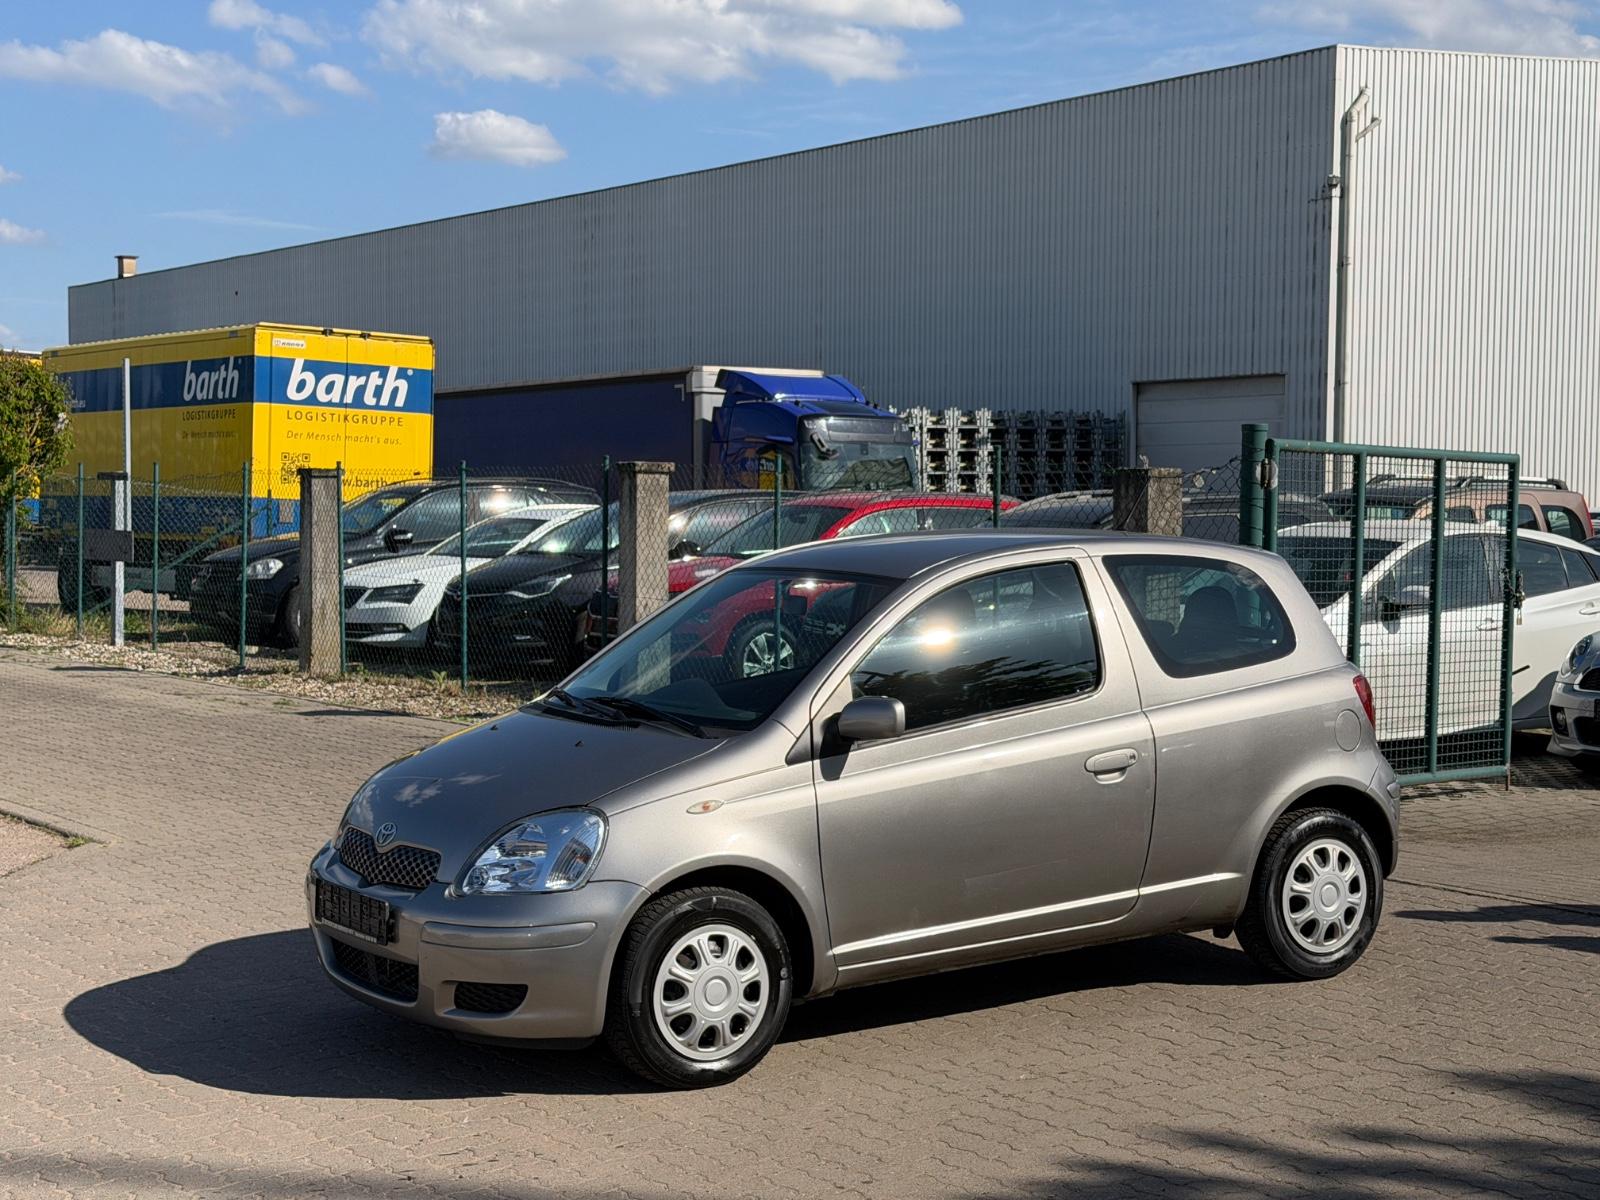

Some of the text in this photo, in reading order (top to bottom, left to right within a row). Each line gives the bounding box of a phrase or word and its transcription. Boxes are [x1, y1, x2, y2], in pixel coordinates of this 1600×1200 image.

[183, 356, 239, 401] barth
[286, 358, 409, 407] barth
[182, 408, 237, 421] LOGISTIKGRUPPE
[286, 410, 404, 427] LOGISTIKGRUPPE
[286, 430, 303, 439] Der
[306, 431, 342, 442] Mensch
[345, 433, 381, 444] macht's
